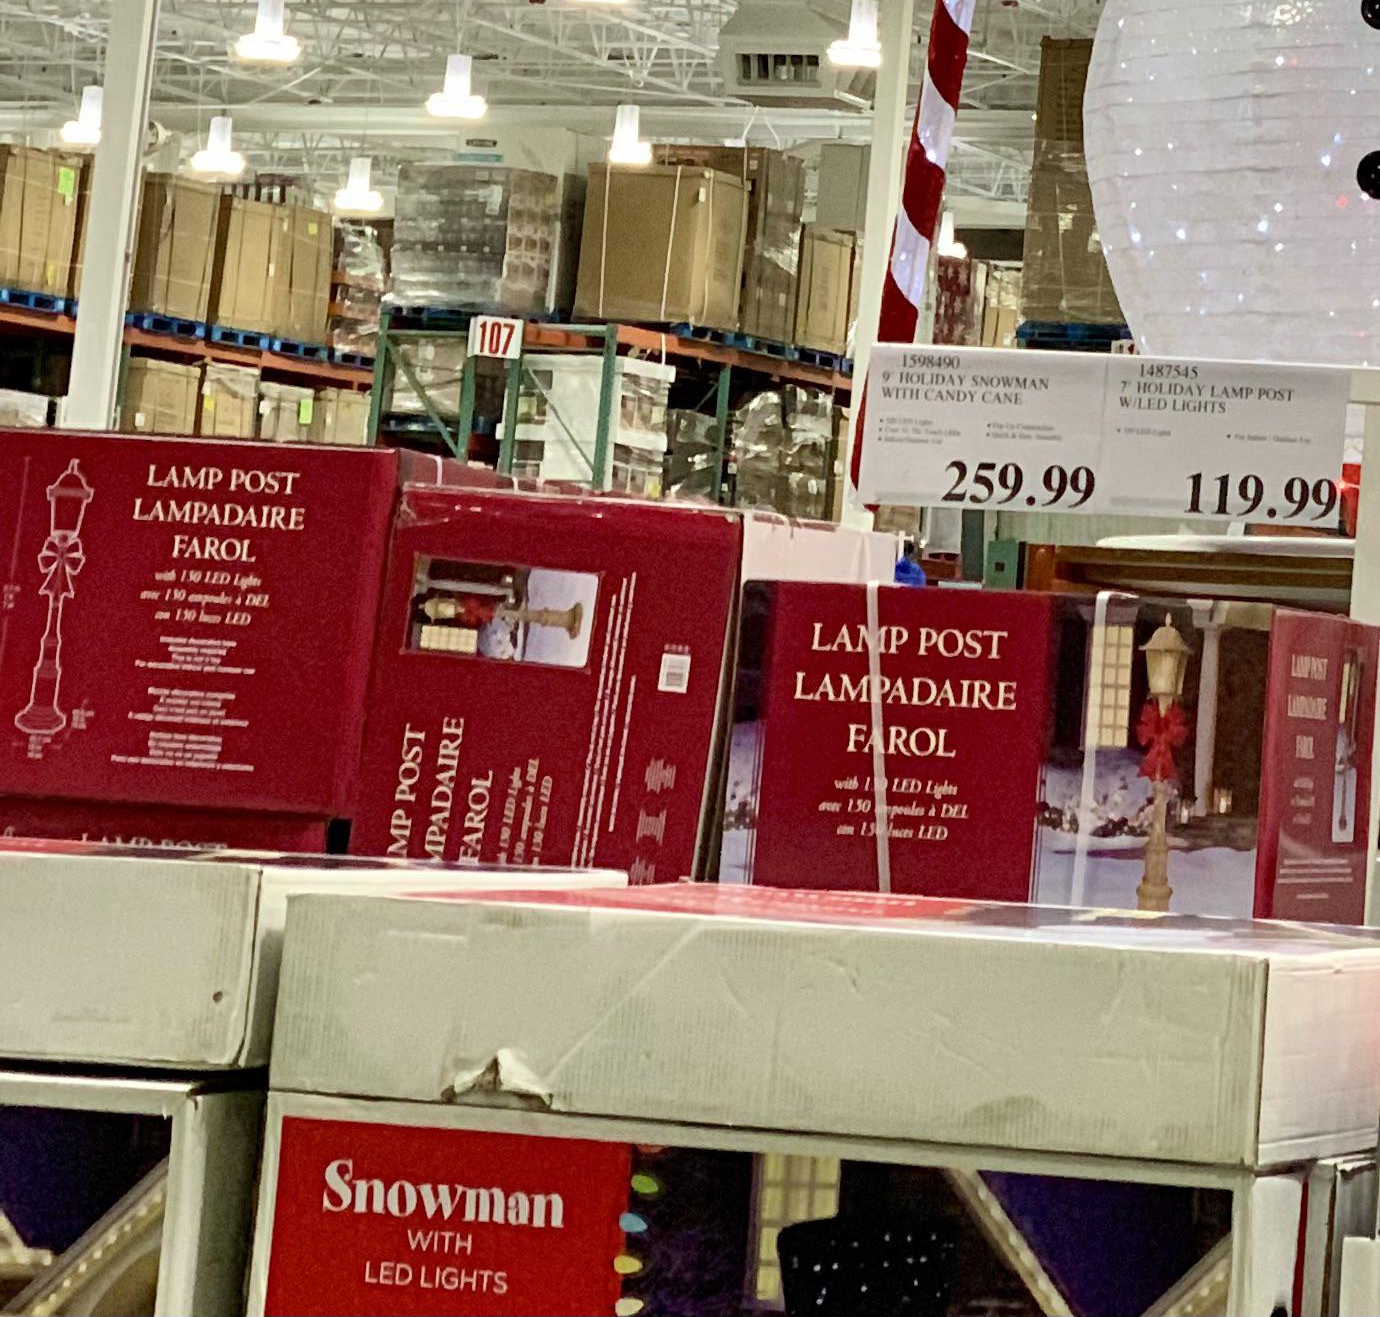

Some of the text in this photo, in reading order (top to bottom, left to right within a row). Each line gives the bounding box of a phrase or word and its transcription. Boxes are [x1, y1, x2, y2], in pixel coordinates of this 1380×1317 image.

[480, 321, 516, 355] 107
[901, 353, 961, 370] 1598490
[1139, 363, 1199, 379] 1487545
[899, 371, 968, 388] HOLIDAY
[971, 375, 1049, 391] SNOWMAN
[1137, 381, 1207, 397] HOLIDAY
[1210, 385, 1254, 400] LAMP
[1257, 387, 1296, 402] POST
[881, 386, 1024, 406] WITH CANDY CANE
[1119, 395, 1227, 414] W/LED LIGHTS
[147, 464, 300, 495] LAMP POST
[941, 459, 1096, 509] 259.99
[1184, 471, 1338, 521] 119.99
[133, 497, 305, 531] LAMPADAIRE
[172, 534, 257, 563] FAROL
[204, 571, 232, 585] LED
[225, 612, 252, 626] LED
[811, 622, 1009, 660] LAMP POST
[793, 671, 1018, 710] LAMPADAIRE
[387, 722, 426, 858] MP POST
[424, 716, 465, 862] MPADAIRE
[892, 777, 922, 794] LED
[458, 769, 494, 864] FAROL
[847, 798, 871, 813] 150
[917, 824, 949, 841] LED
[322, 1158, 565, 1228] Snowman
[407, 1229, 473, 1255] WITH
[364, 1261, 508, 1294] LED LIGHTS
